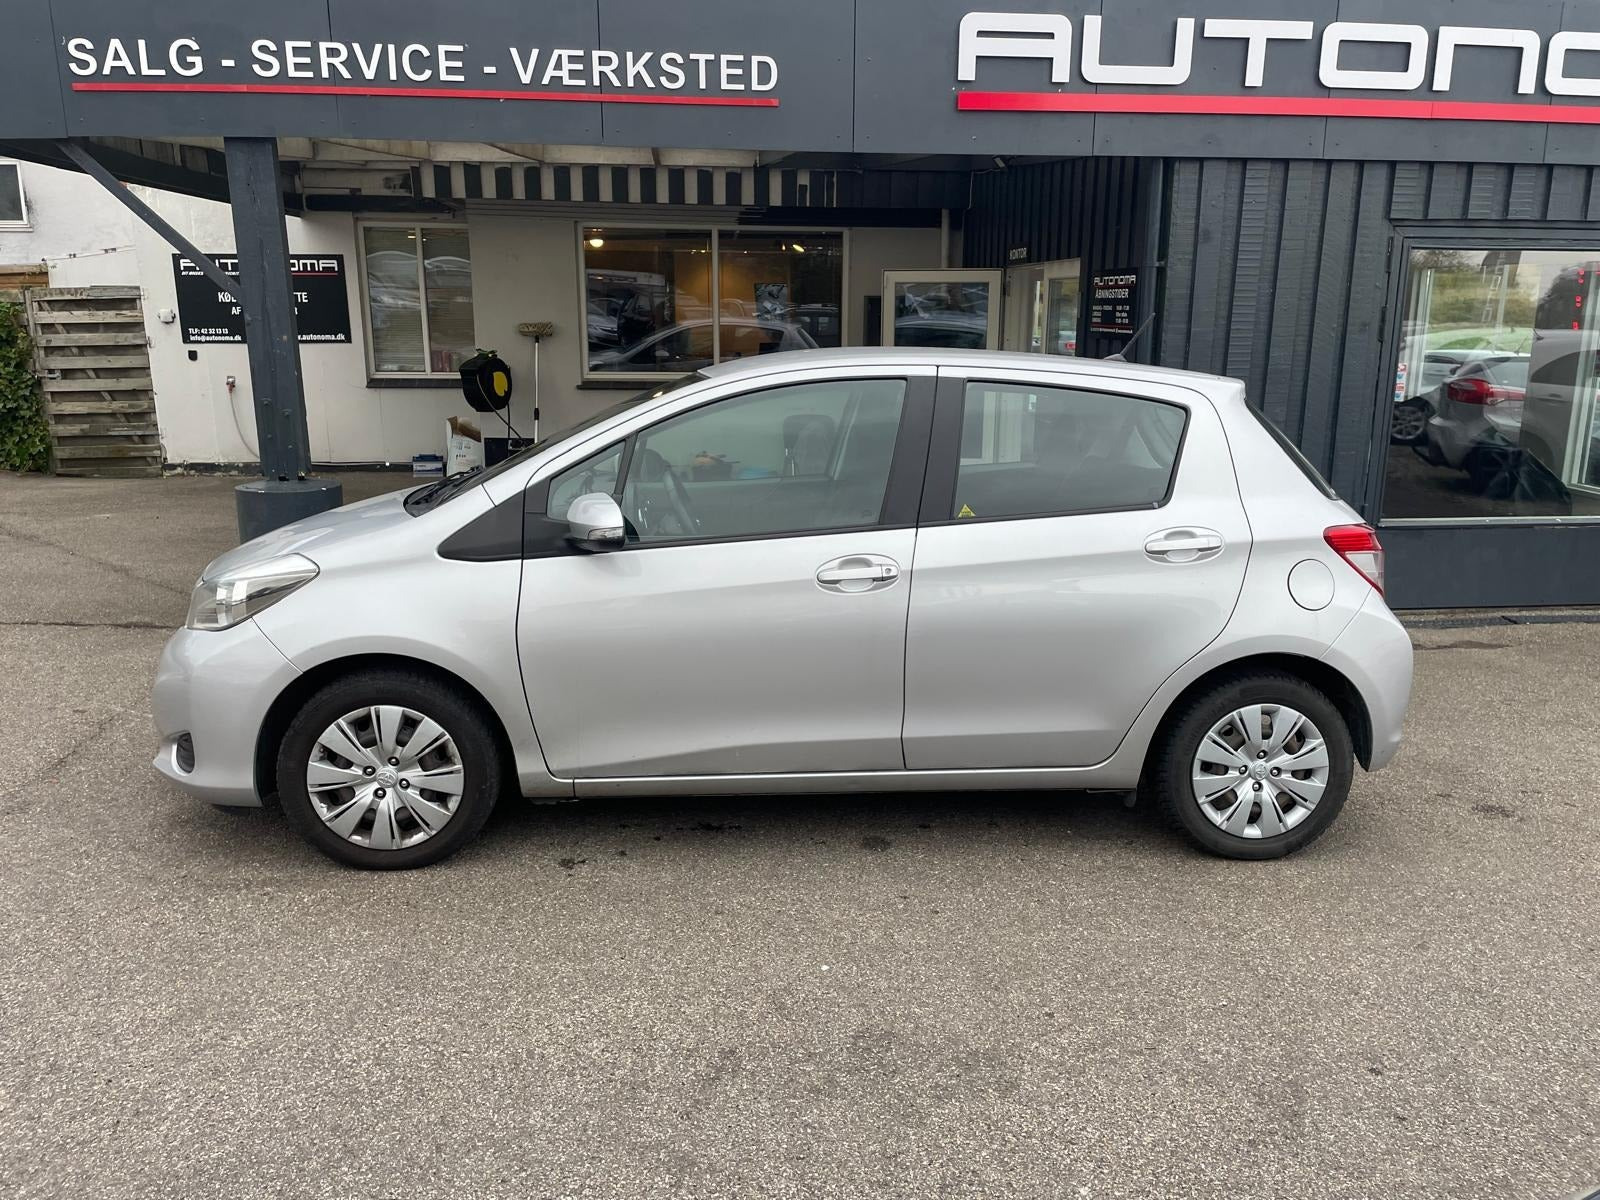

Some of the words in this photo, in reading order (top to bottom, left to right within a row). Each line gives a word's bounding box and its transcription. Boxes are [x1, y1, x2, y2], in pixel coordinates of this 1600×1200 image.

[67, 37, 204, 77] SALG
[251, 39, 465, 82] SERVICE
[509, 47, 779, 91] VÆRKSTED
[1094, 275, 1136, 285] AUTONOMA
